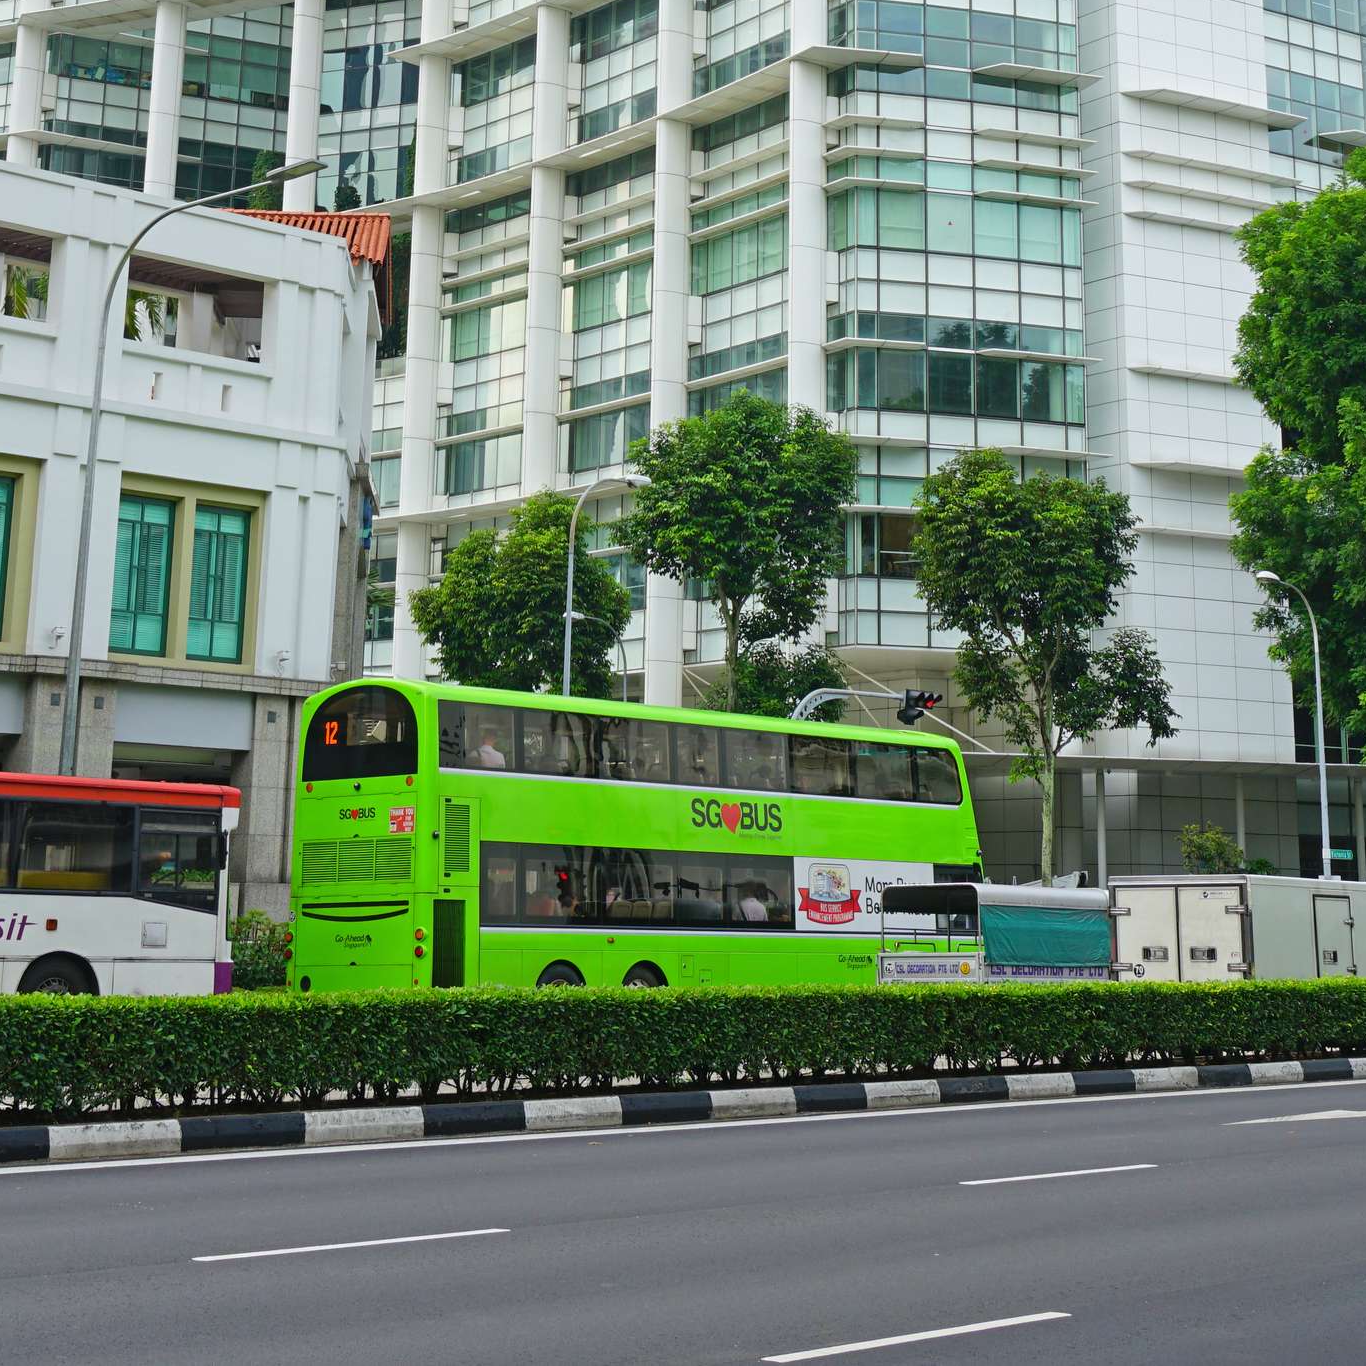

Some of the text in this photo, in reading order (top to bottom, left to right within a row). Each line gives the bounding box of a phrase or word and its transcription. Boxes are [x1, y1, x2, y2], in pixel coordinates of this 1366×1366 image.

[325, 721, 339, 745] 12
[896, 962, 959, 974] CSL DECORATION PTE LTD
